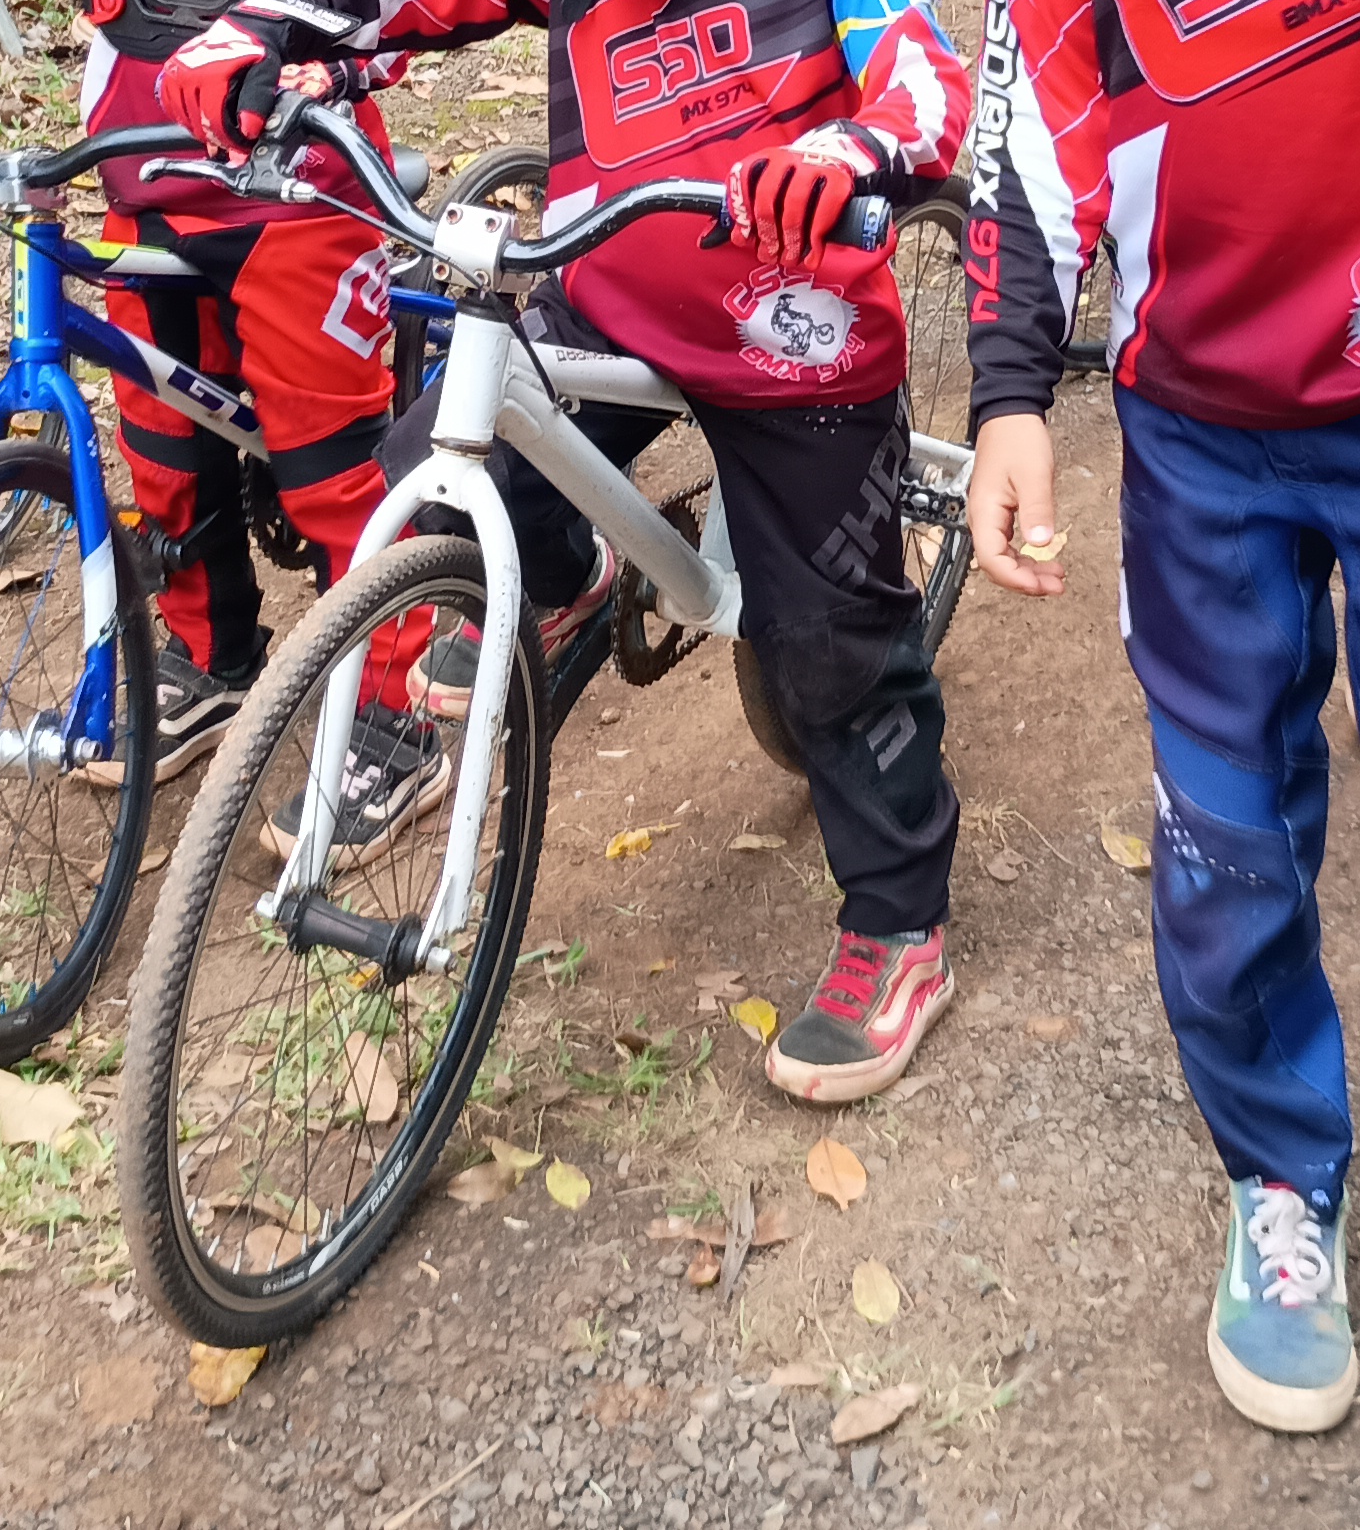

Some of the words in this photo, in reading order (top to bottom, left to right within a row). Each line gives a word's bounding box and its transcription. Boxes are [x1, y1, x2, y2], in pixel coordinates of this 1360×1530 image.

[715, 80, 757, 110] 974
[965, 218, 1001, 323] 974
[739, 346, 806, 383] BMX
[816, 333, 866, 384] 974
